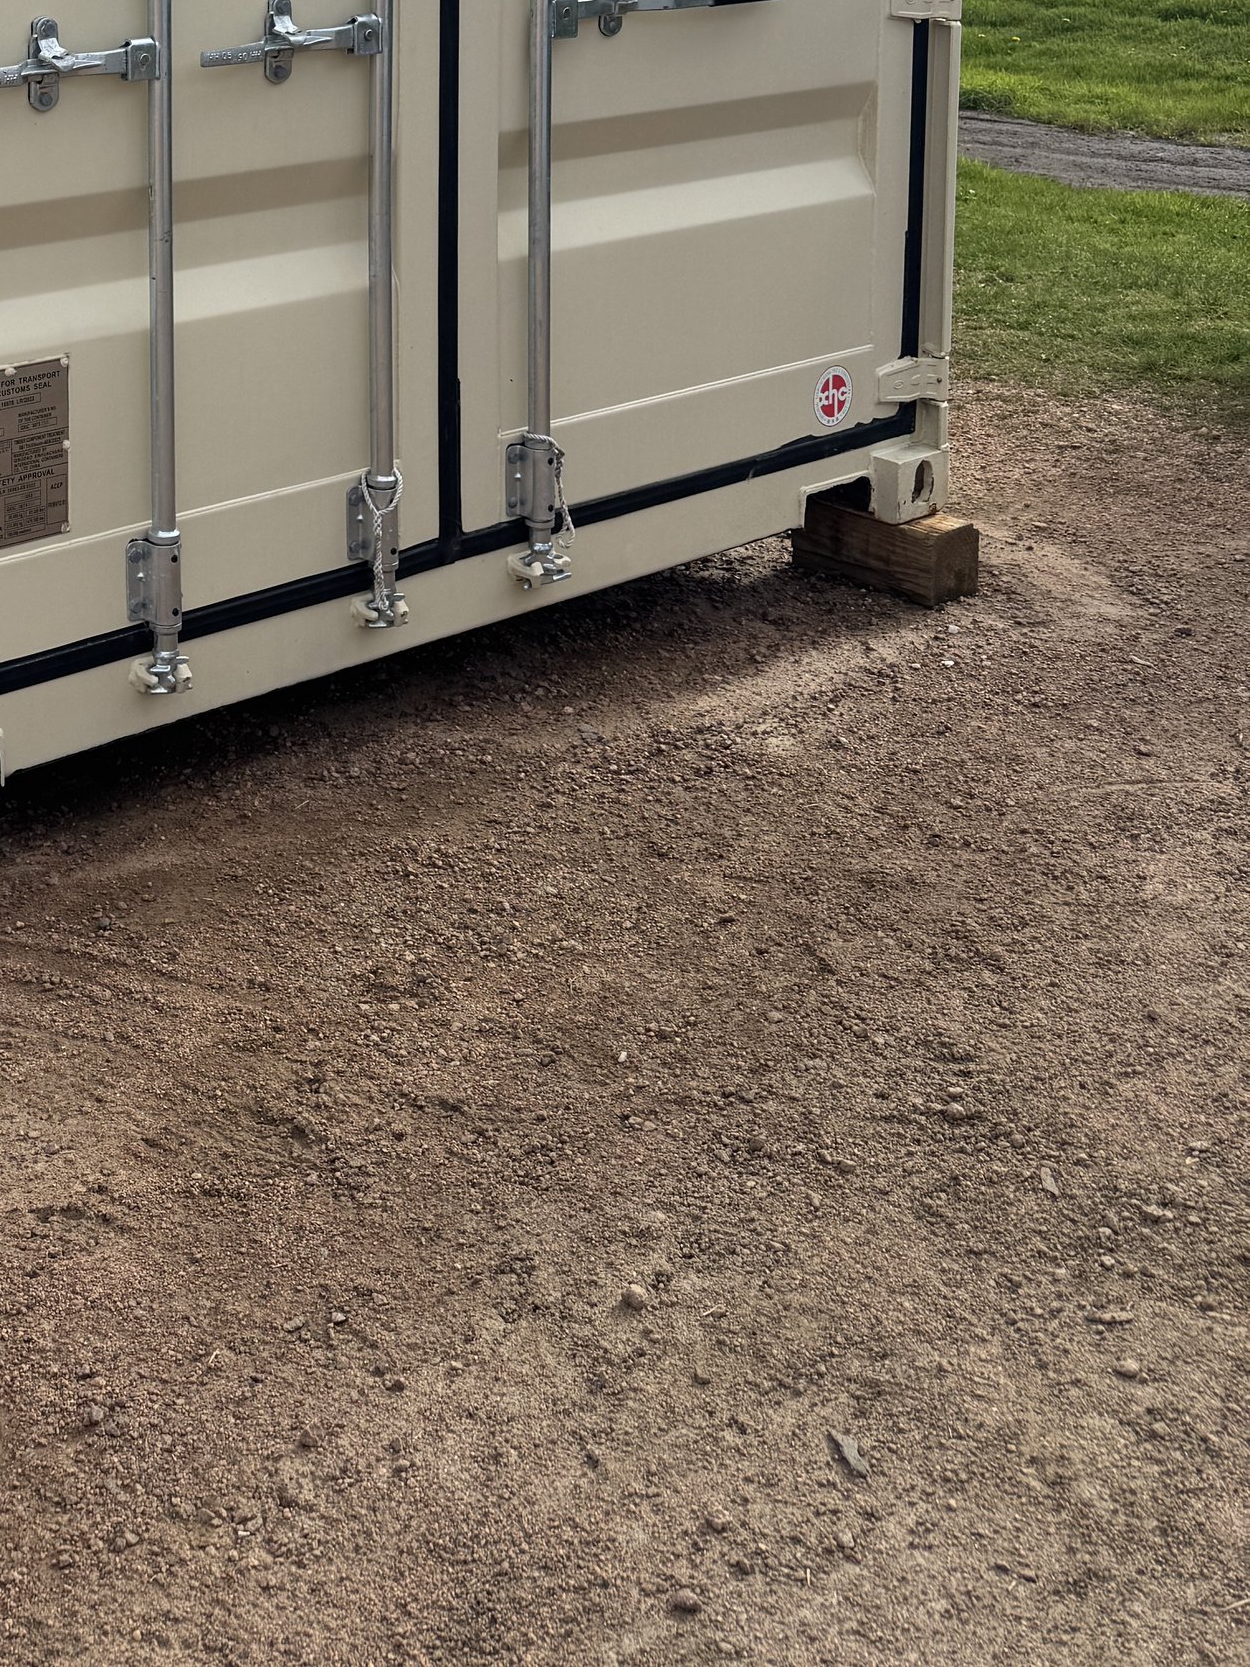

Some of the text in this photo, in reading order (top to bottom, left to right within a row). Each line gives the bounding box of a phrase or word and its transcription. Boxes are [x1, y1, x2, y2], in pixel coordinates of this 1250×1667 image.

[1, 379, 16, 387] FOR
[19, 370, 61, 384] TRANSPORT
[33, 381, 52, 390] SEAL
[18, 468, 55, 482] APPROVAL
